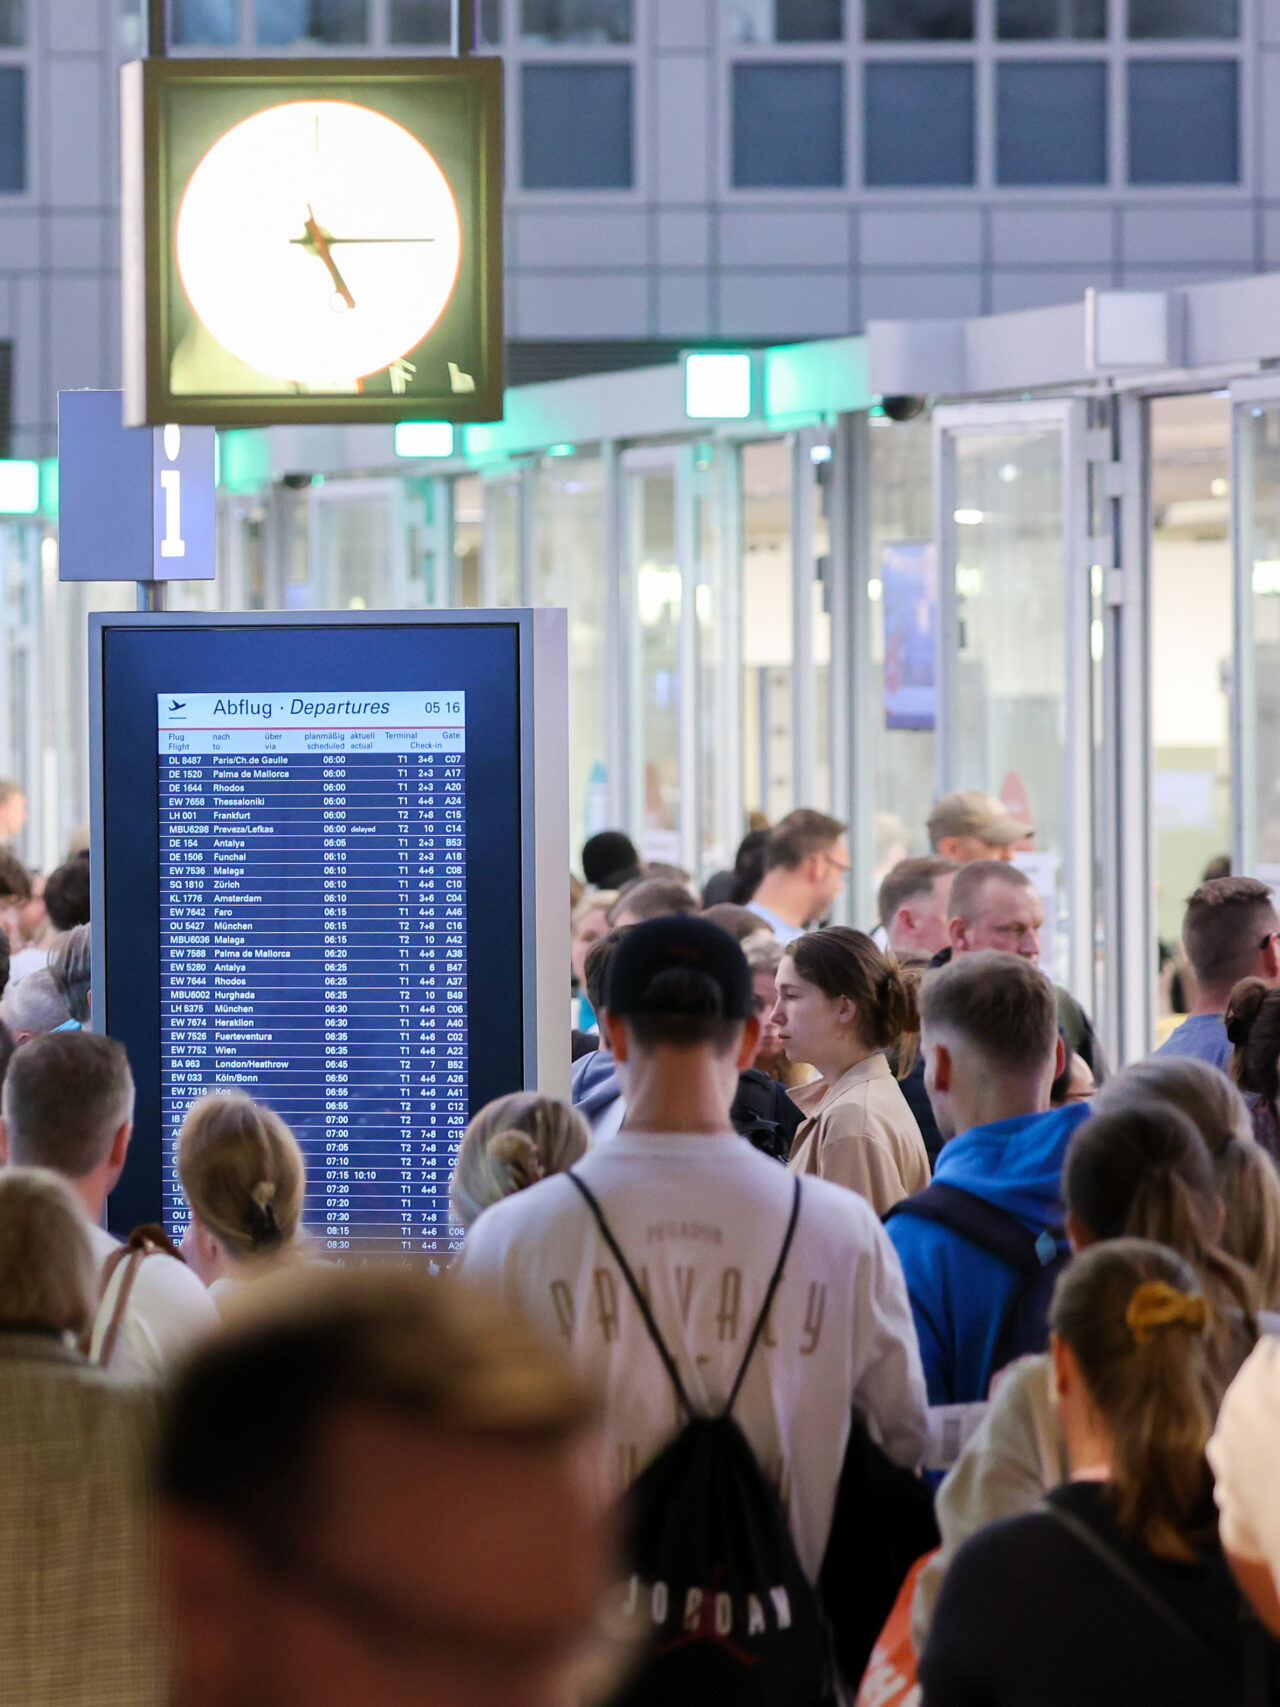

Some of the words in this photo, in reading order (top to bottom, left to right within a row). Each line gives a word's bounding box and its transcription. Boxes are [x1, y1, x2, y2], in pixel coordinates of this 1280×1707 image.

[213, 699, 272, 719] Abflug
[290, 698, 390, 718] Departures
[425, 702, 440, 714] 05
[446, 701, 461, 714] 16
[168, 732, 185, 742] Flug
[304, 732, 345, 741] planmäßig
[384, 732, 418, 740] Terminal
[442, 731, 460, 739] Gate
[168, 742, 190, 752] Flight
[350, 741, 373, 750] actual
[410, 741, 442, 749] Check-in
[169, 756, 180, 764] DL
[261, 756, 288, 764] Gaulle
[323, 755, 346, 764] 06:00
[398, 755, 407, 763] T1
[418, 755, 433, 763] 3+6
[445, 755, 461, 763] C07
[169, 770, 180, 778] DE
[254, 770, 289, 778] Mallorca
[323, 769, 346, 778] 06:00
[398, 769, 407, 777] T1
[418, 769, 434, 777] 2+3
[444, 768, 461, 777] A17
[169, 784, 180, 792] DE
[213, 784, 244, 792] Rhodos
[323, 783, 346, 792] 06:00
[418, 783, 434, 791] 2+3
[444, 782, 462, 791] A20
[169, 798, 184, 806] EW
[213, 797, 264, 806] Thessaloniki
[323, 797, 346, 805] 06:00
[398, 797, 408, 805] T1
[418, 796, 434, 805] 4+6
[445, 796, 462, 805] A24
[169, 812, 180, 820] LH
[214, 811, 251, 819] Frankfurt
[324, 811, 346, 819] 06:00
[398, 810, 408, 819] T2
[418, 810, 434, 819] 7+8
[445, 810, 462, 819] C15
[214, 825, 274, 833] Preveza/Lefkas
[323, 824, 346, 833] 06:00
[398, 824, 408, 833] T2
[424, 824, 434, 832] 10
[446, 824, 462, 832] C14
[169, 839, 181, 847] DE
[213, 839, 245, 848] Antalya
[324, 838, 346, 847] 06:05
[398, 838, 408, 846] T1
[419, 838, 434, 847] 2+3
[446, 838, 462, 846] B53
[169, 853, 181, 861] DE
[214, 852, 246, 861] Funchal
[324, 852, 346, 861] 06:10
[398, 852, 408, 860] T1
[419, 852, 434, 861] 2+3
[445, 852, 462, 860] A18
[170, 866, 184, 875] EW
[214, 866, 244, 876] Malaga
[324, 866, 346, 874] 06:10
[398, 866, 408, 874] T1
[419, 866, 434, 874] 4+6
[446, 866, 462, 874] C08
[170, 880, 182, 888] SQ
[214, 880, 240, 888] Zürich
[324, 880, 346, 888] 06:10
[398, 880, 408, 888] T1
[419, 880, 434, 888] 4+6
[446, 880, 462, 888] C10
[170, 894, 181, 902] KL
[324, 894, 347, 902] 06:10
[398, 894, 408, 902] T1
[419, 894, 434, 902] 3+6
[446, 894, 462, 902] C04
[170, 908, 184, 916] EW
[214, 908, 232, 916] Faro
[324, 908, 347, 916] 06:15
[398, 908, 408, 916] T1
[419, 908, 434, 916] 4+6
[446, 908, 462, 916] A46
[170, 922, 183, 930] OU
[214, 922, 253, 930] München
[324, 922, 347, 930] 06:15
[398, 921, 409, 930] T2
[419, 921, 434, 930] 7+8
[446, 922, 462, 930] C16
[214, 936, 245, 946] Malaga
[324, 935, 347, 944] 06:15
[399, 935, 410, 944] T2
[425, 936, 435, 944] 10
[446, 935, 462, 944] A42
[170, 949, 184, 958] EW
[214, 949, 240, 958] Palma
[242, 950, 252, 958] de
[255, 949, 290, 958] Mallorca
[324, 949, 347, 958] 06:20
[399, 949, 409, 958] T1
[419, 949, 435, 958] 4+6
[446, 949, 463, 958] A38
[171, 1060, 184, 1068] BA
[215, 1060, 289, 1068] London/Heathrow
[325, 1060, 348, 1068] 06:45
[400, 1060, 411, 1069] T2
[430, 1060, 435, 1069] 7
[448, 1060, 463, 1069] B52
[171, 1073, 186, 1082] EW
[216, 1074, 258, 1082] Köln/Bonn
[326, 1074, 348, 1082] 06:50
[400, 1074, 410, 1082] T1
[420, 1074, 436, 1083] 4+6
[447, 1074, 464, 1083] A26
